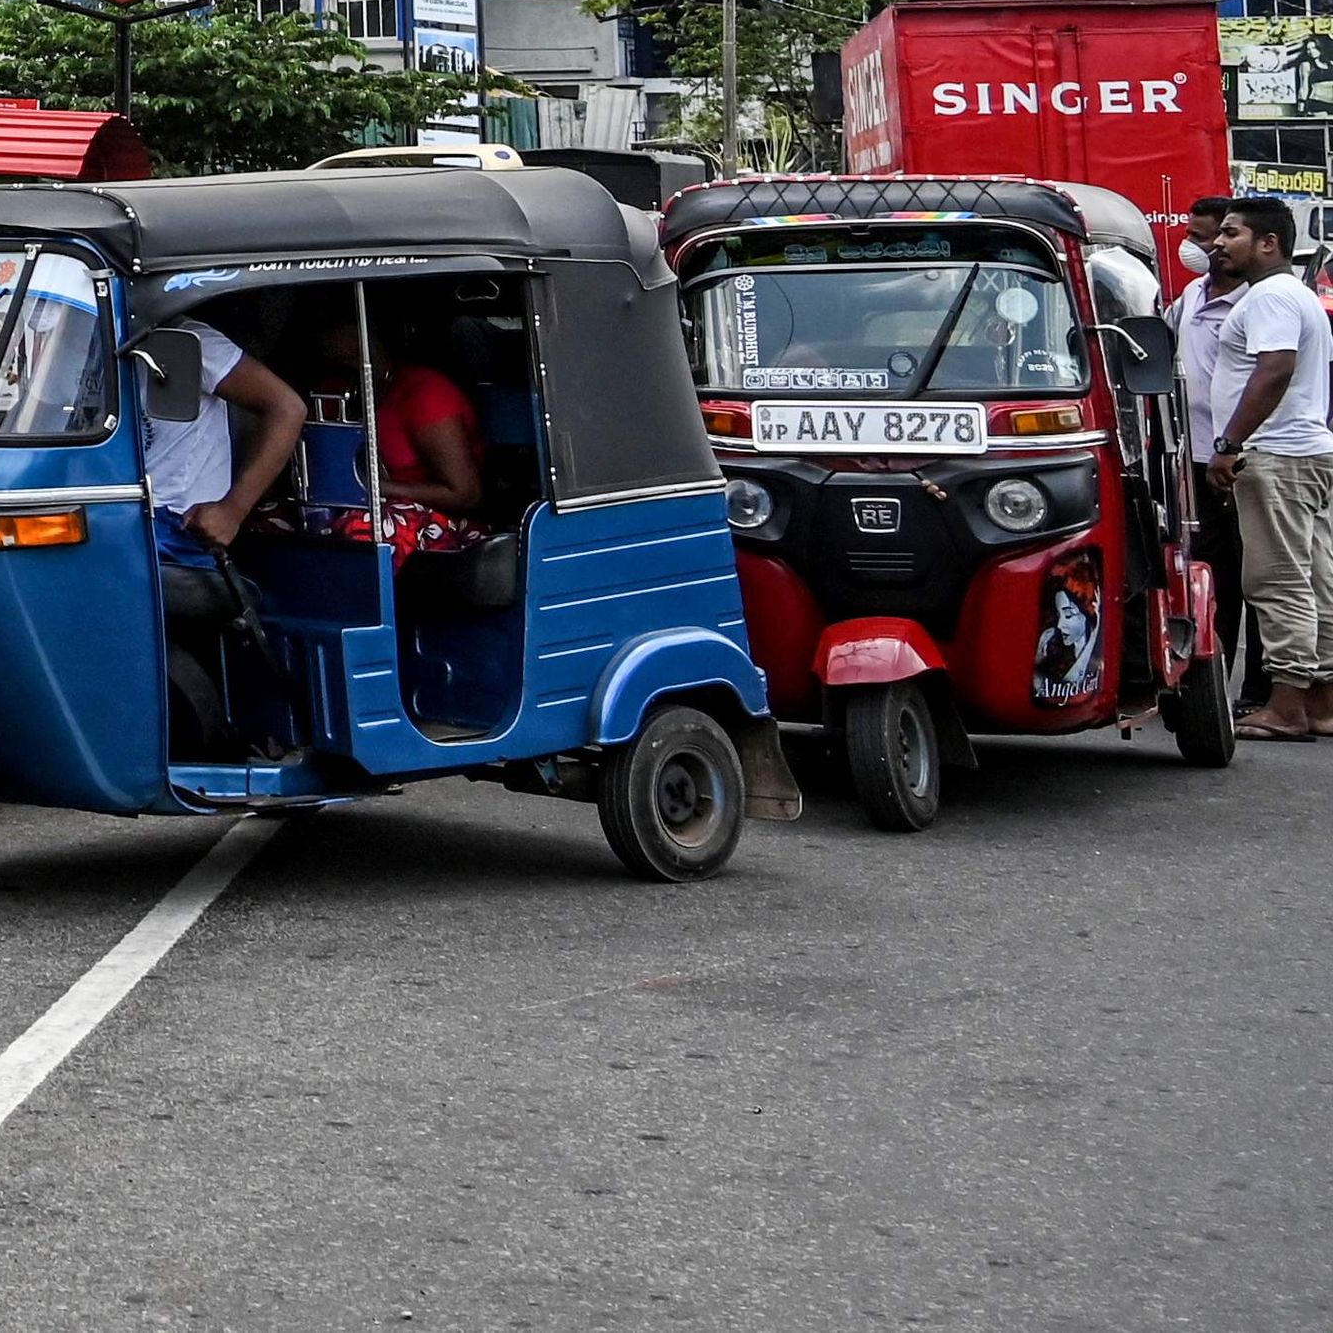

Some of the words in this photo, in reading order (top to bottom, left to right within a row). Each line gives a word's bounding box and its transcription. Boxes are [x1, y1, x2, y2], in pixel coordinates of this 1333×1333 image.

[932, 79, 1183, 116] SINGER
[1145, 210, 1191, 227] singe
[744, 311, 760, 367] BUDDHIST
[760, 424, 788, 440] WP
[796, 410, 866, 441] AAY
[883, 411, 976, 443] 8278
[861, 509, 894, 525] RE
